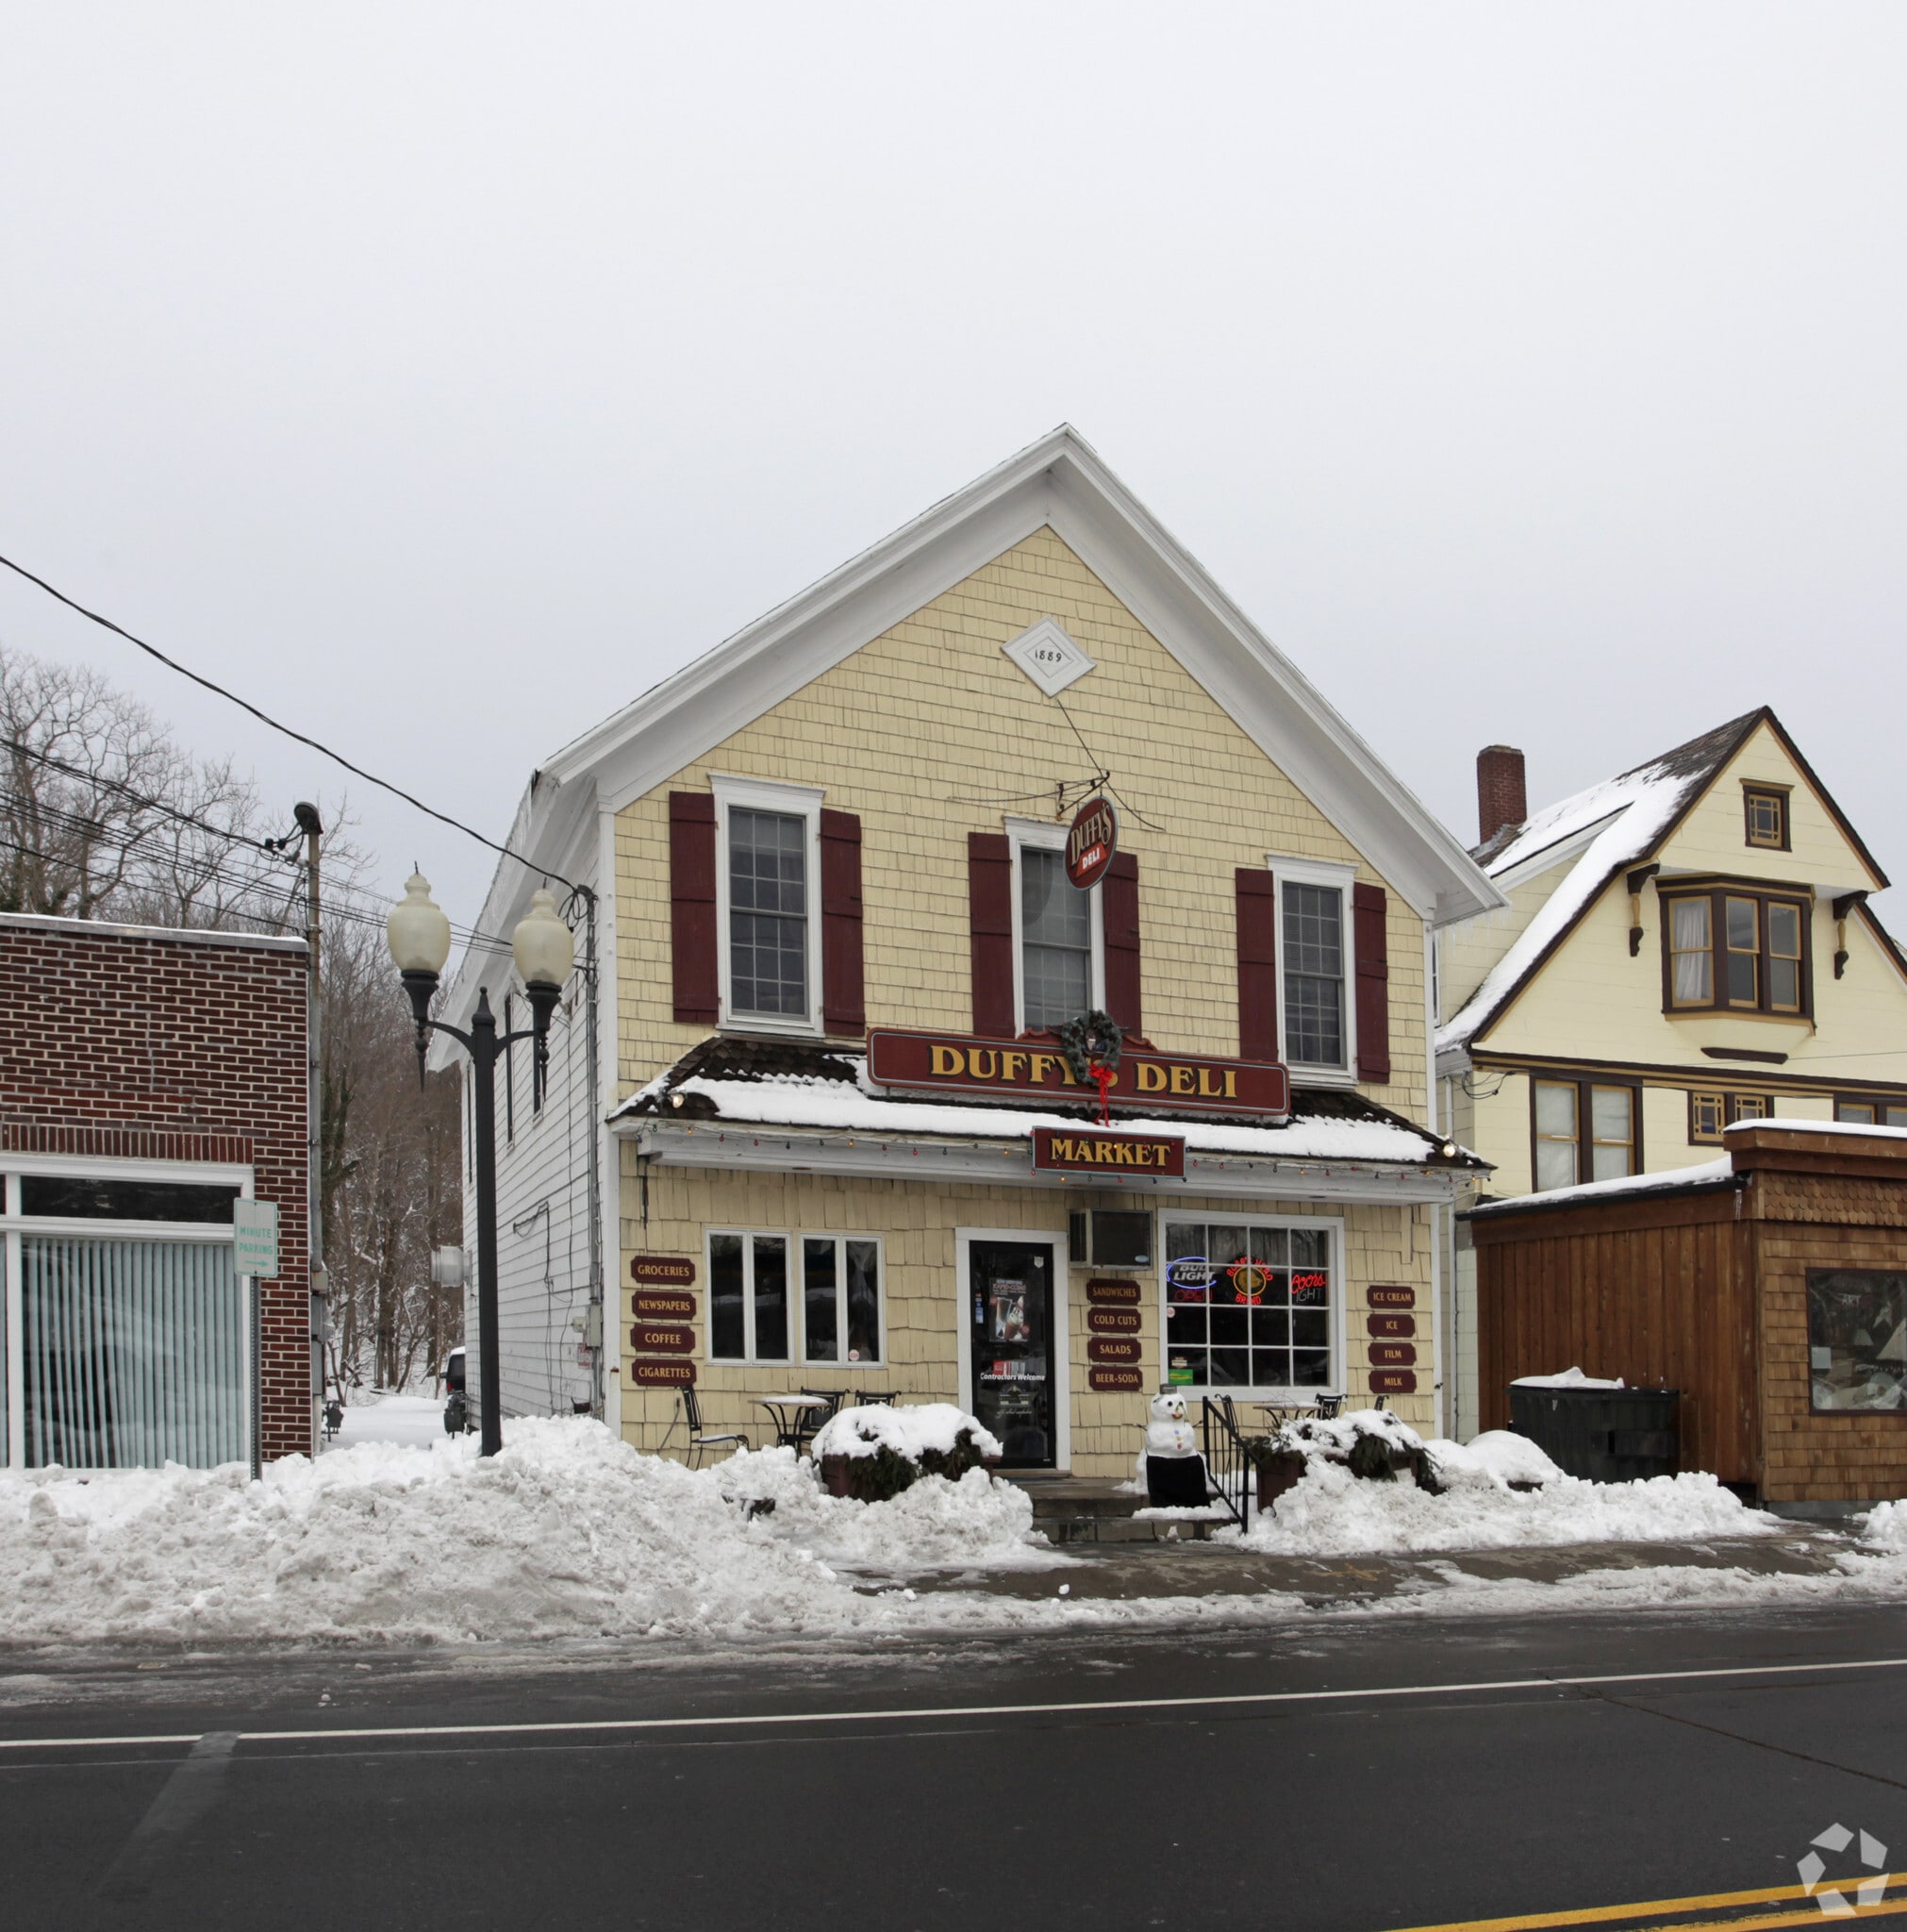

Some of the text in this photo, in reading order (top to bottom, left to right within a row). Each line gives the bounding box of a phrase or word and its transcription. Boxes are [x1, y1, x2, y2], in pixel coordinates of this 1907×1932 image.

[1035, 648, 1062, 662] 1889
[1070, 802, 1112, 866] DUFFY'S
[1082, 847, 1100, 870] DELI
[1136, 1062, 1237, 1098] DELI
[1050, 1138, 1170, 1167] MARKET
[240, 1226, 272, 1239] MINUTE
[239, 1242, 273, 1255] PARKING
[638, 1264, 689, 1276] GROCERIES
[1173, 1272, 1216, 1280] LIGHT
[1092, 1287, 1136, 1298] SANDWICHES
[1373, 1292, 1411, 1302] ICE CREAM
[638, 1299, 690, 1311] NEWSPAPERS
[1094, 1315, 1137, 1325] COLD CUTS
[1385, 1321, 1398, 1329] ICE
[644, 1332, 681, 1344] COFFEE
[1100, 1344, 1132, 1355] SALADS
[1385, 1349, 1401, 1358] FILM
[638, 1366, 690, 1378] CIGARETTES
[980, 1373, 1046, 1381] Contractors Welcome
[1095, 1373, 1138, 1383] BEER-SODA
[1384, 1377, 1402, 1386] MILK
